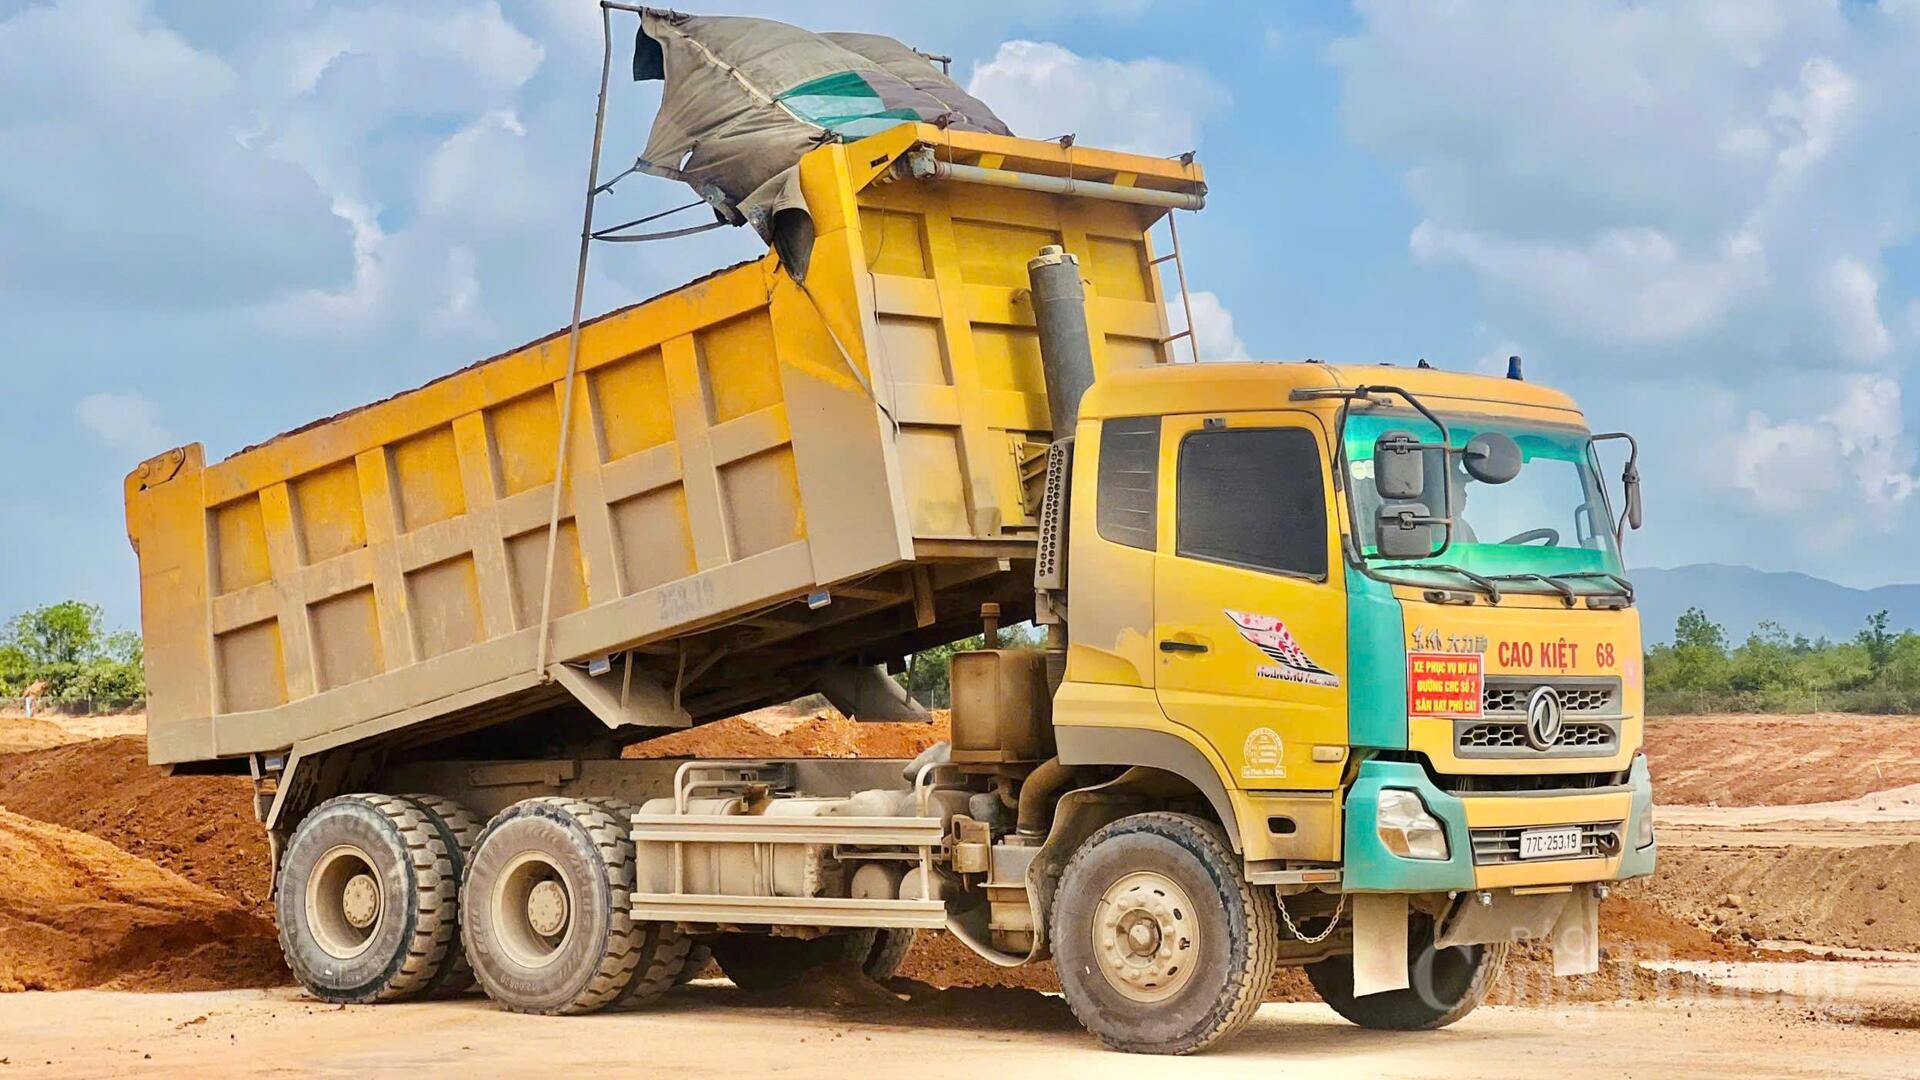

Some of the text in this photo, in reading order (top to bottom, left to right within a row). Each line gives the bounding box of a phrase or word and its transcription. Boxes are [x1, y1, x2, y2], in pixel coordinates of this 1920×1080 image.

[1498, 637, 1615, 674] CAO KIỆT 68
[1414, 661, 1424, 673] XE
[1445, 680, 1460, 692] CHC
[1433, 699, 1447, 712] BAY
